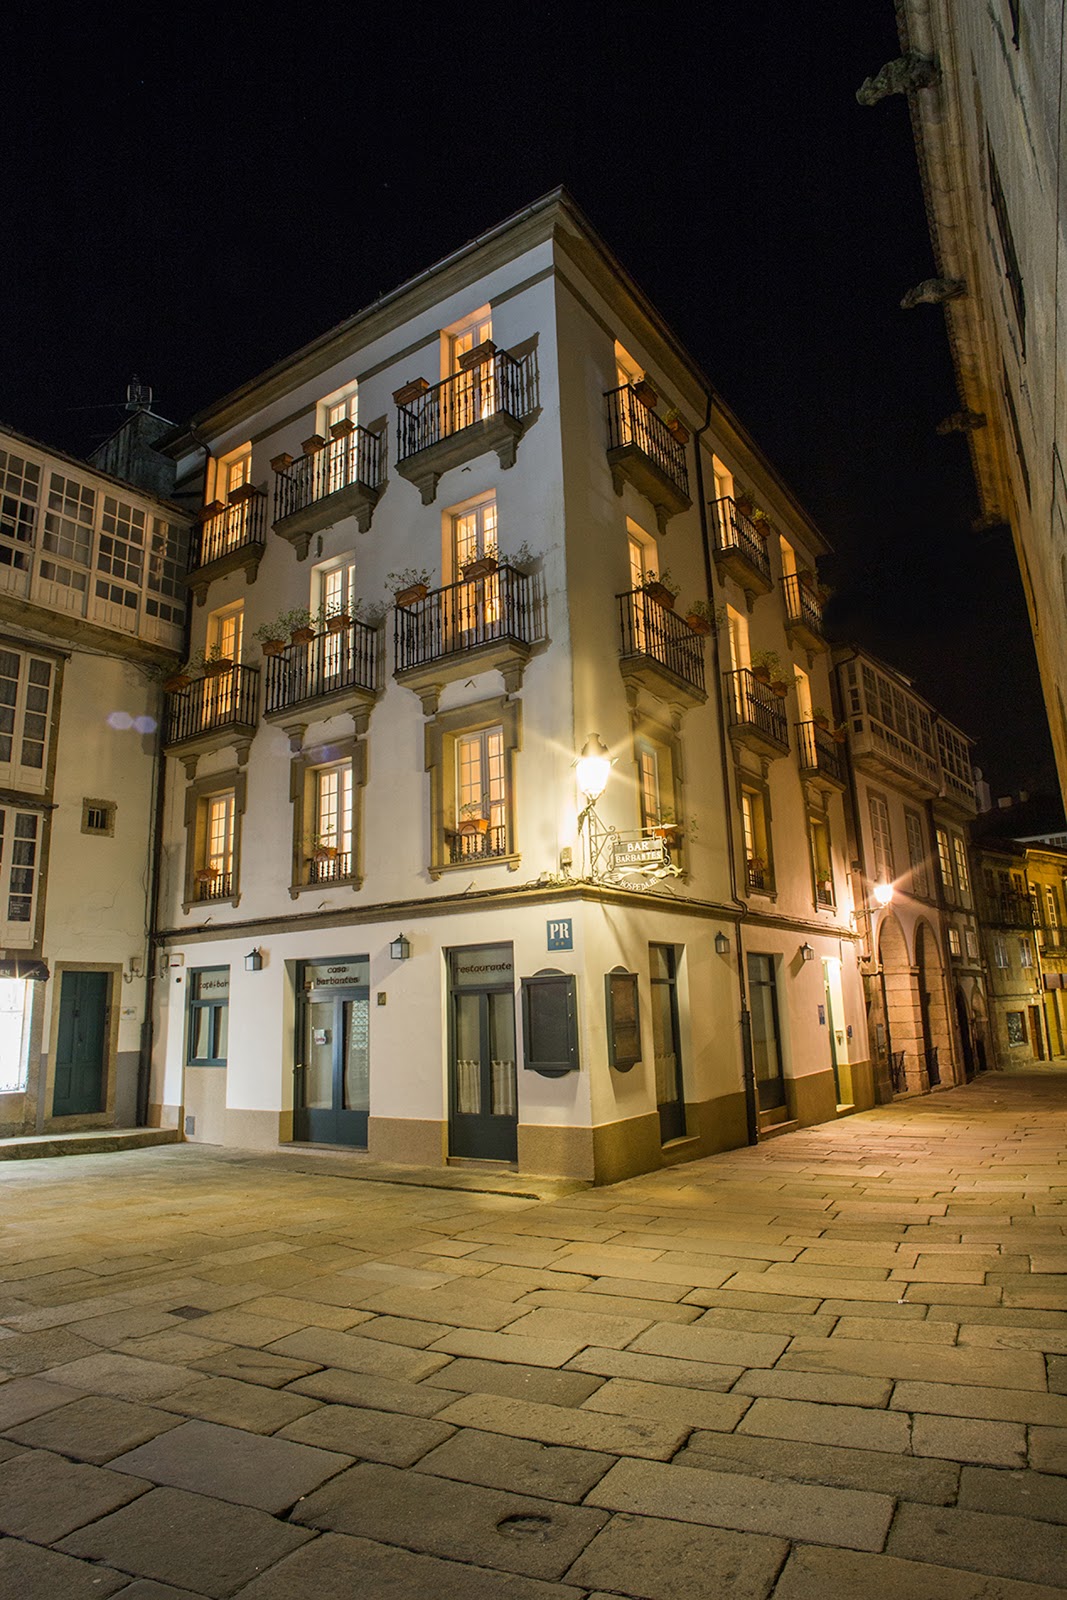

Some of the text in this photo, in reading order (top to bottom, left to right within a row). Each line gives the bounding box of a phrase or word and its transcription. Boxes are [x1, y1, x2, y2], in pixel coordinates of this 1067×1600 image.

[627, 841, 649, 852] BAR
[616, 851, 661, 864] BARBANTES
[550, 922, 570, 939] PR
[327, 966, 347, 974] casa
[456, 963, 512, 974] restaurante
[316, 976, 359, 986] barbantes
